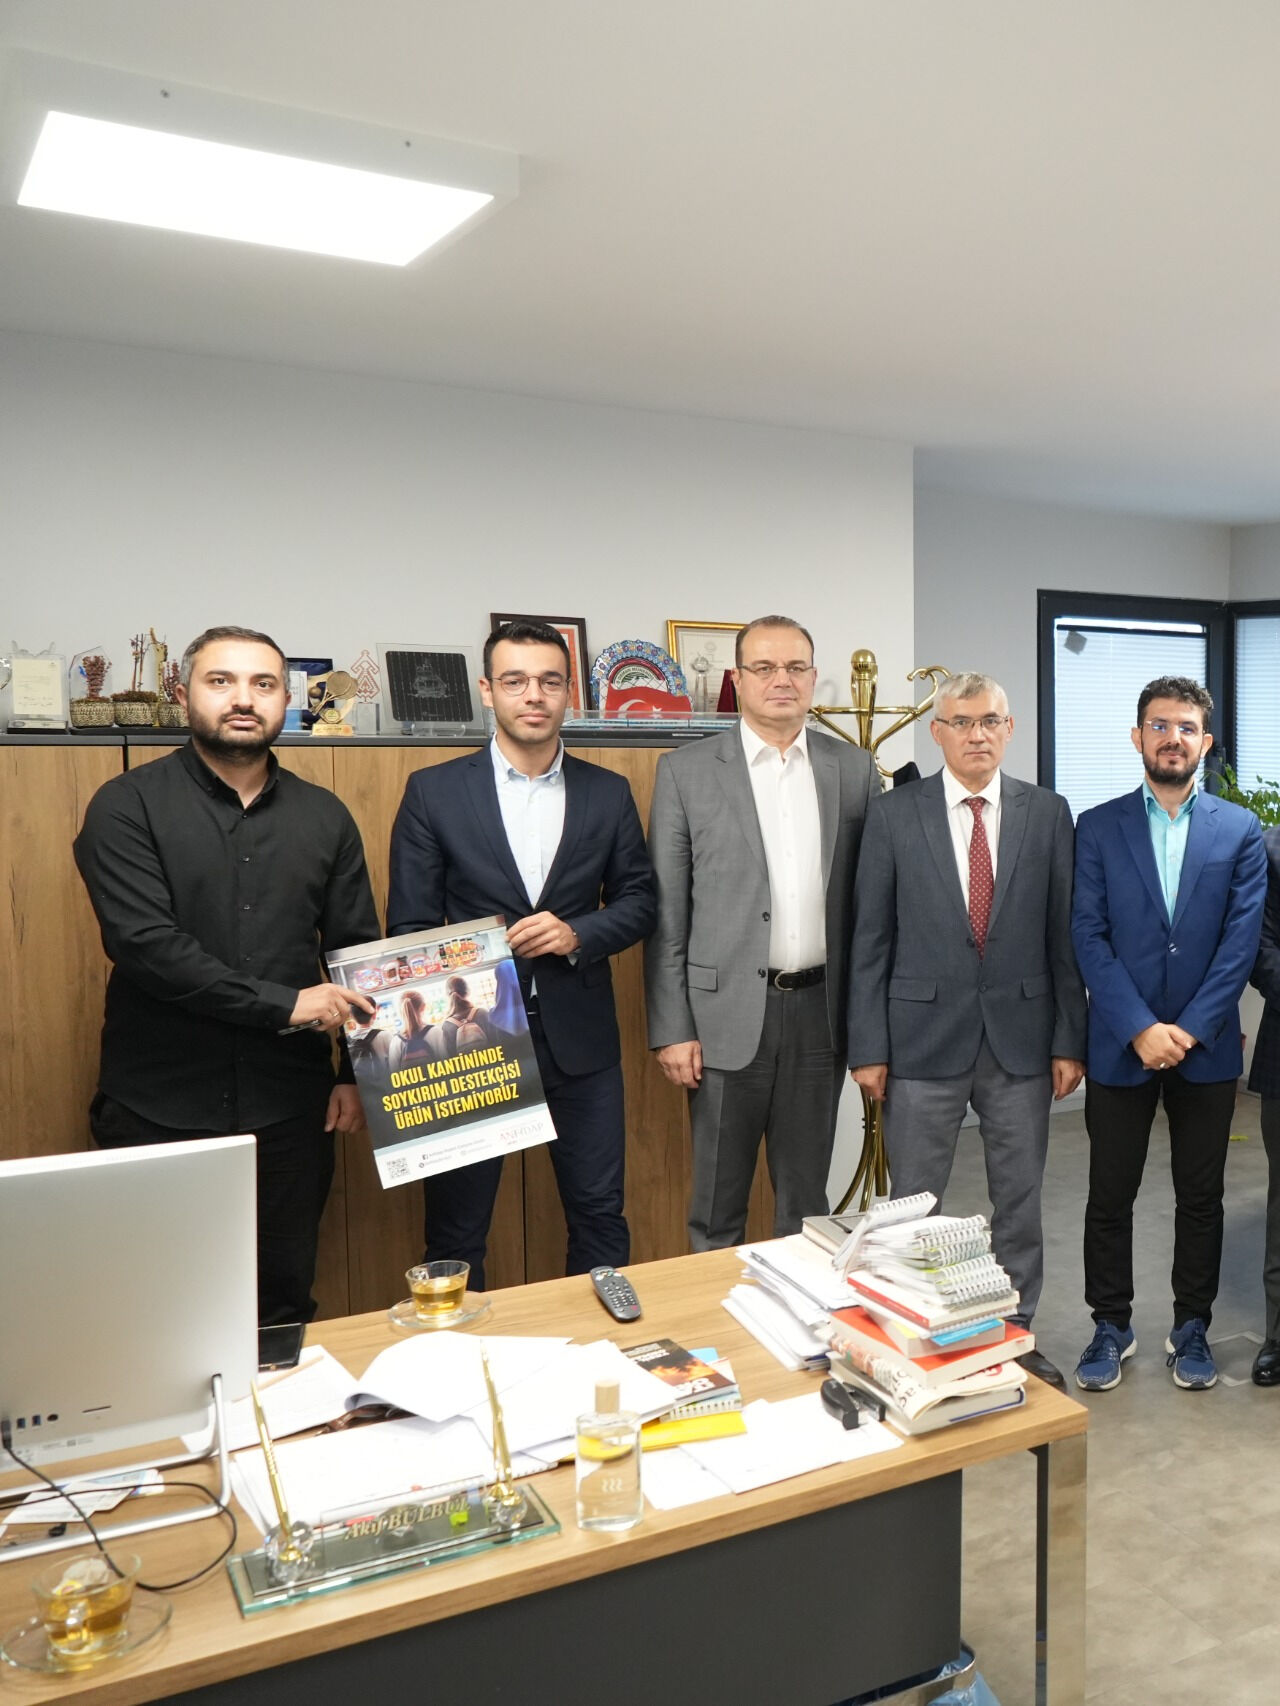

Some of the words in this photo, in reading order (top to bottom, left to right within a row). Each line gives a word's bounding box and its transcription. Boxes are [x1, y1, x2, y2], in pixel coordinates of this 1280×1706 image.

[382, 1080, 448, 1112] SOYKIRIM
[450, 1059, 522, 1094] DESTEKÇİSİ
[390, 1066, 426, 1089] OKUL
[428, 1046, 504, 1079] KANTİNİNDE
[394, 1106, 433, 1130] ÜRÜN
[436, 1083, 520, 1119] İSTEMİYORUZ
[344, 1521, 383, 1540] Akif
